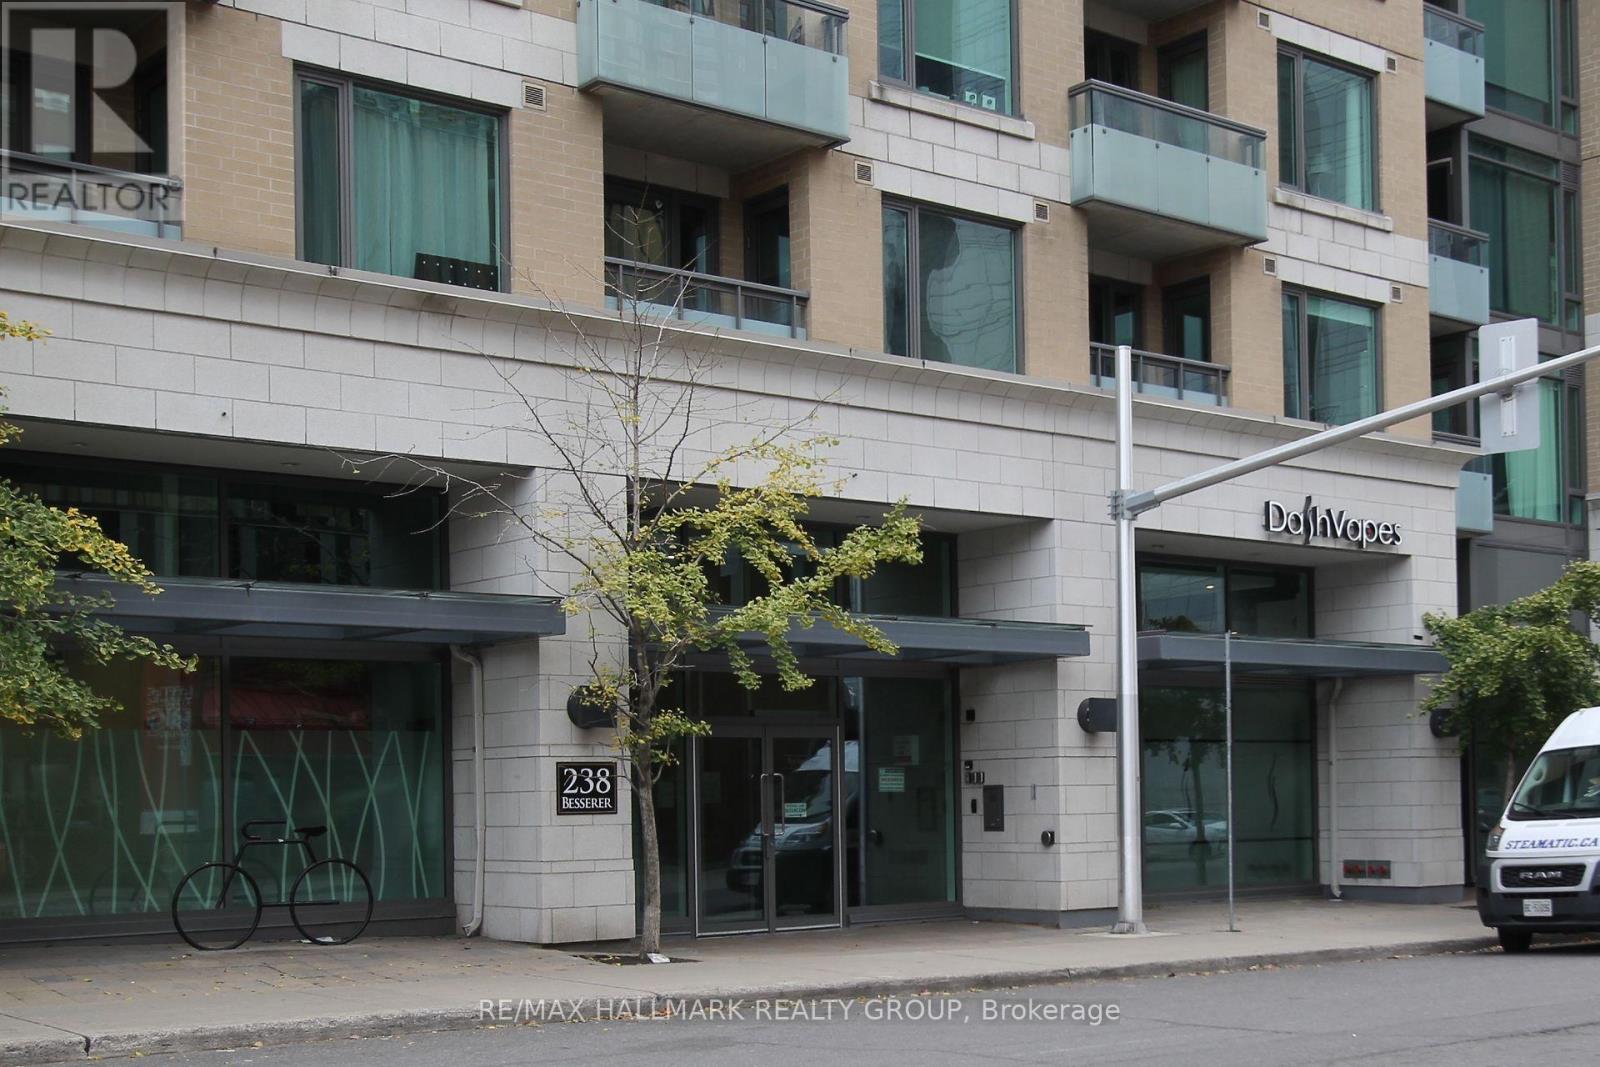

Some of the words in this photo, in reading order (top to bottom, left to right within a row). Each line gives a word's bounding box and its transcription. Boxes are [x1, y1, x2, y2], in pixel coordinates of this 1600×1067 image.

[1264, 495, 1403, 549] DashVapes
[563, 768, 611, 794] 238
[1505, 838, 1598, 850] STEAMATIC.CA
[1519, 871, 1562, 879] RAM
